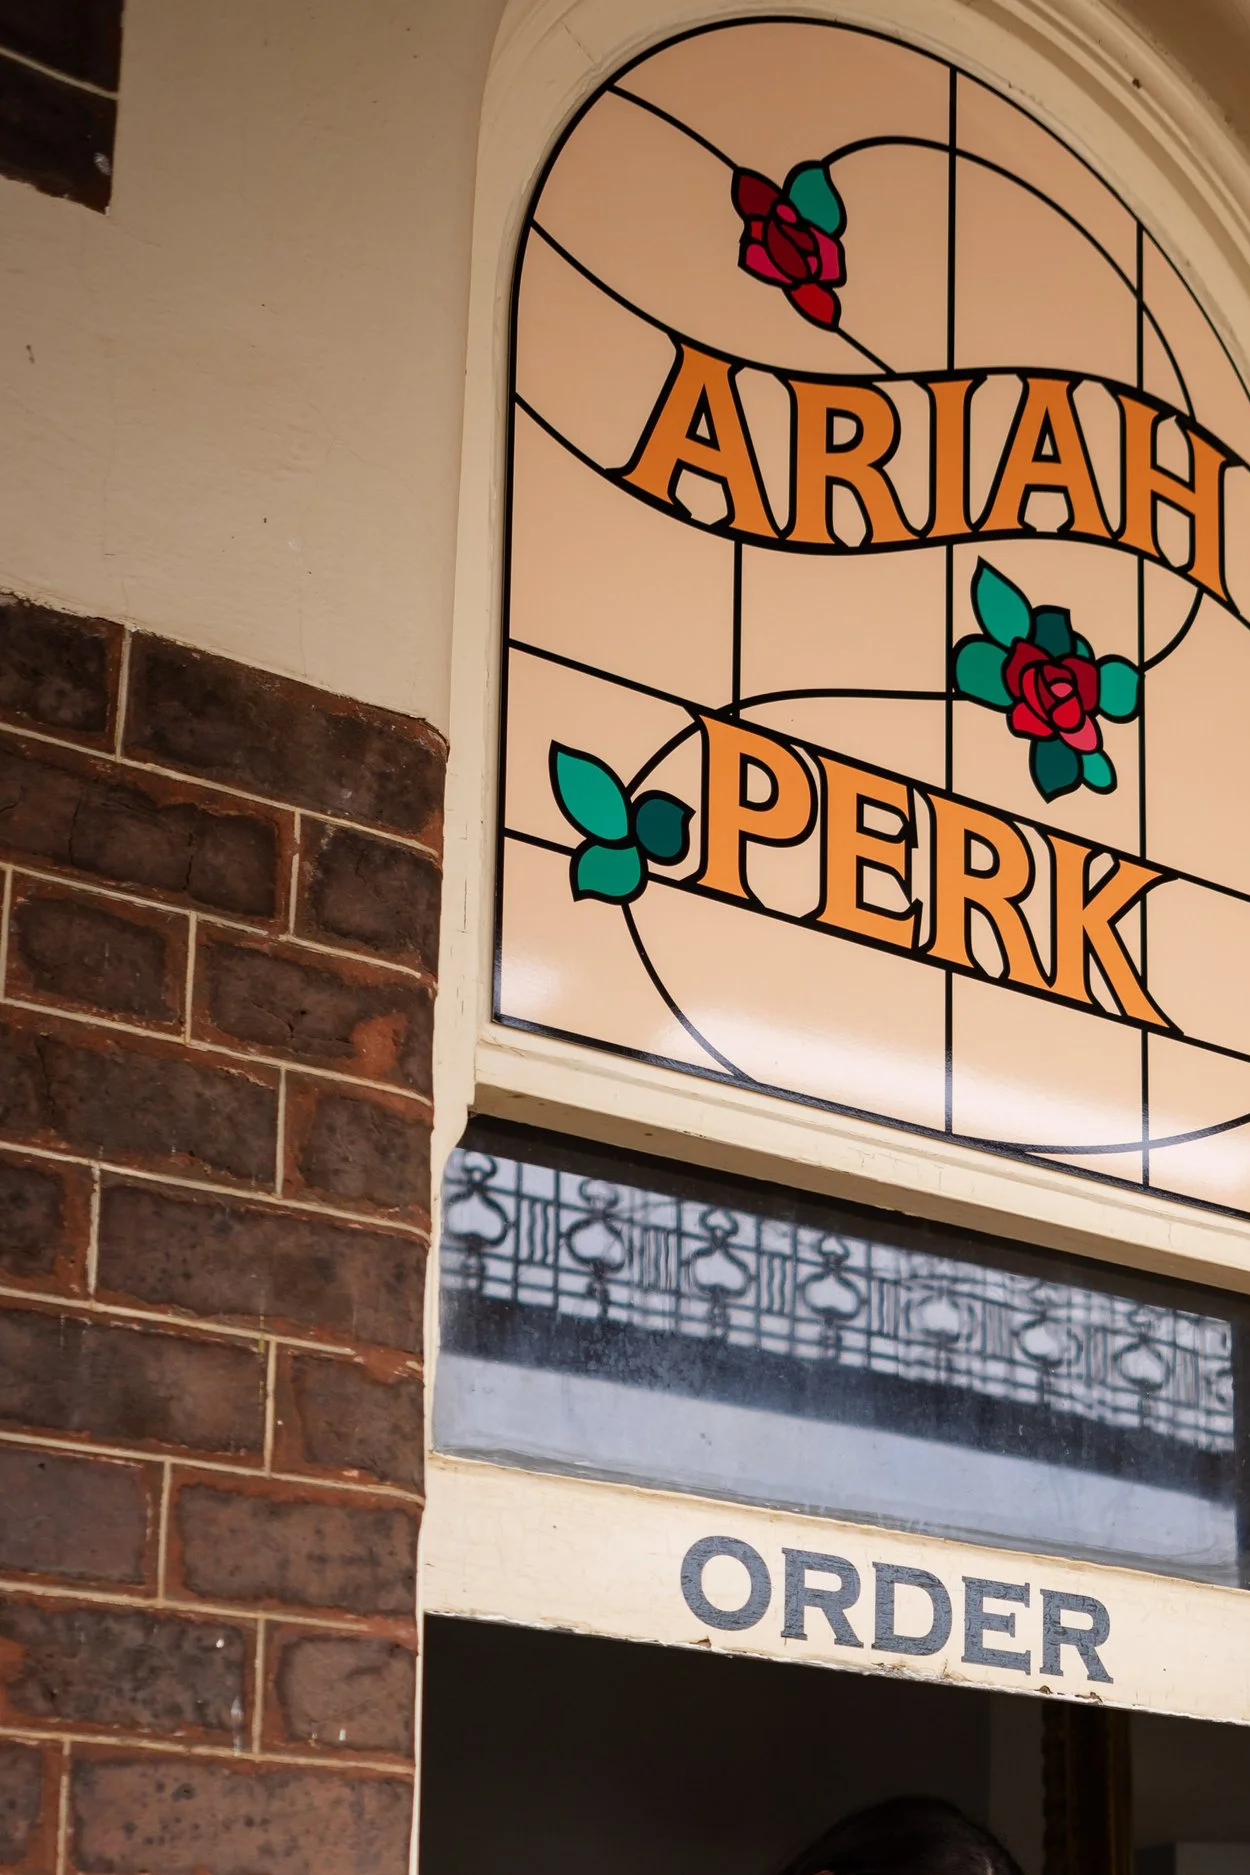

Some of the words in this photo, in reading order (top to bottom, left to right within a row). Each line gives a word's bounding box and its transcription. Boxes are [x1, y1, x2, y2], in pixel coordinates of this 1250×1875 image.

[616, 336, 1234, 606] ARIAH
[694, 711, 1180, 1036] PERK
[680, 1535, 1114, 1684] ORDER
